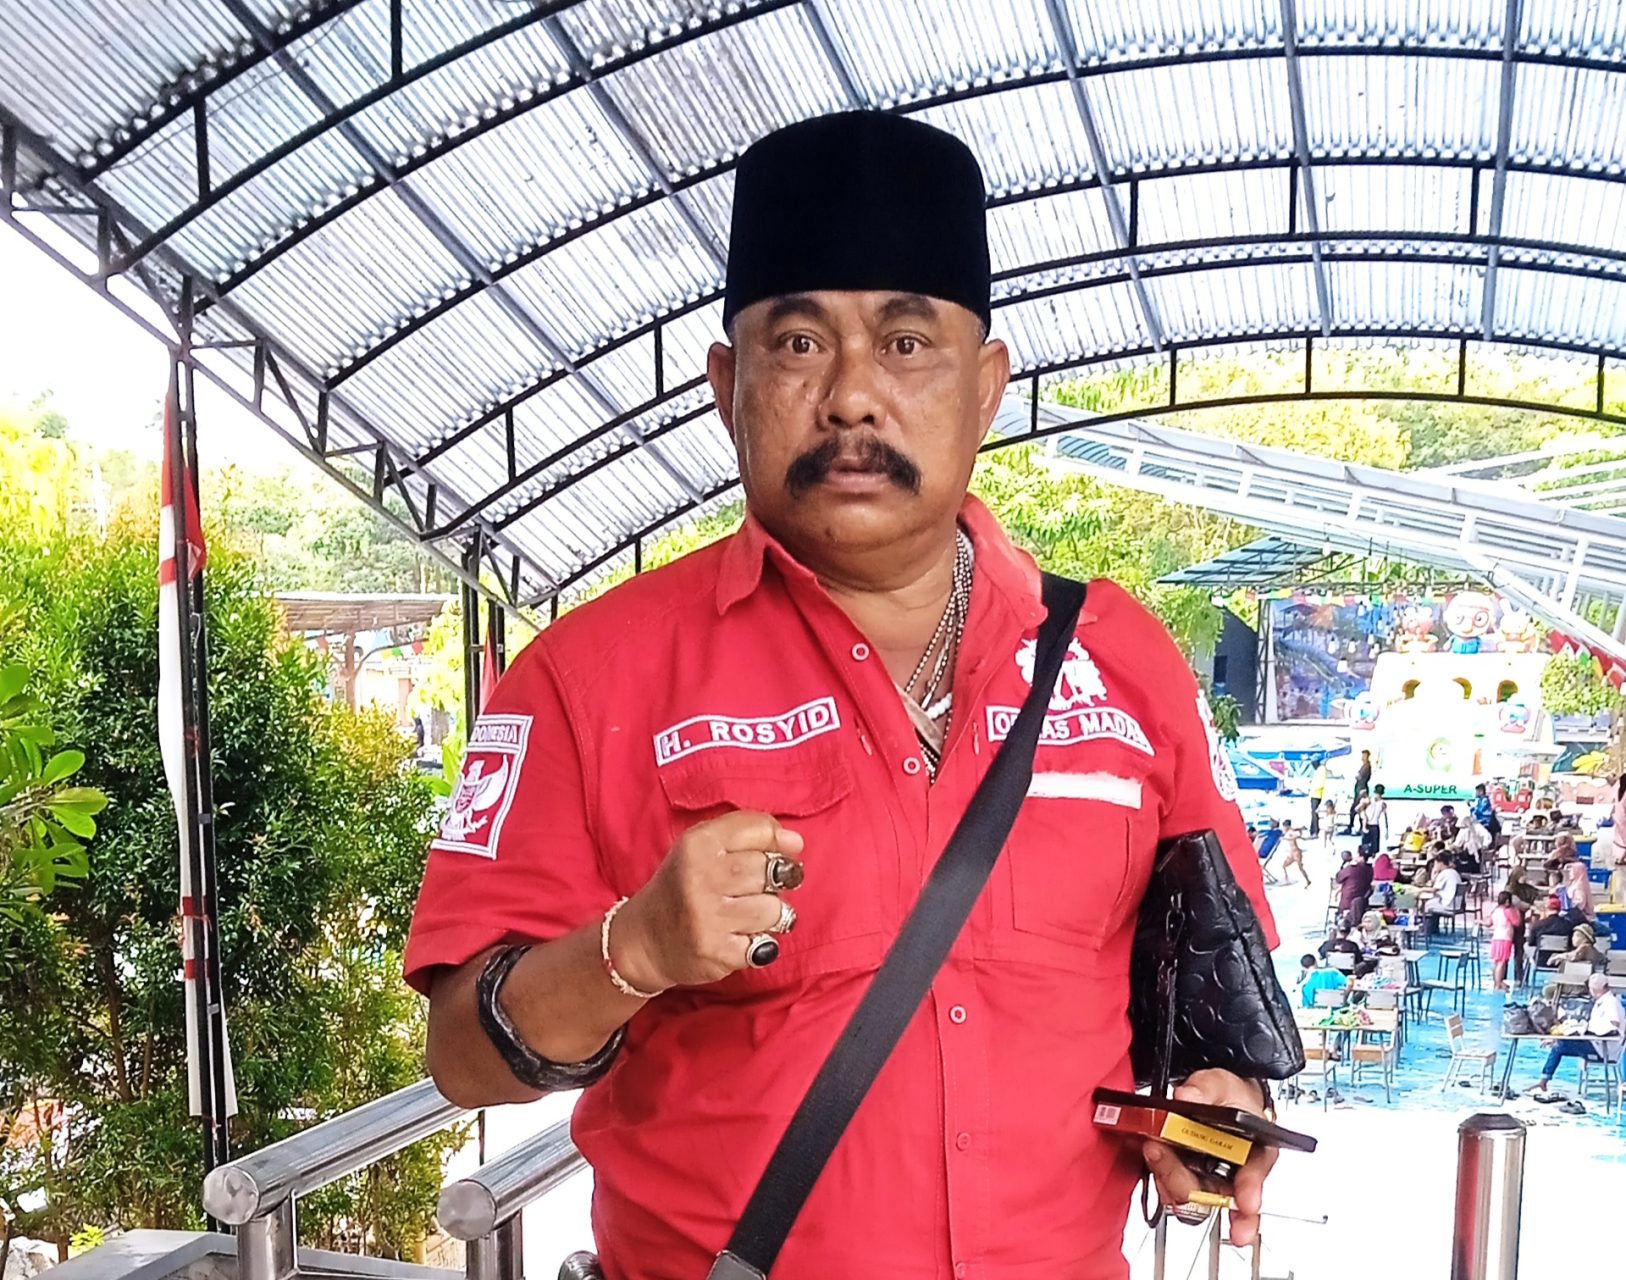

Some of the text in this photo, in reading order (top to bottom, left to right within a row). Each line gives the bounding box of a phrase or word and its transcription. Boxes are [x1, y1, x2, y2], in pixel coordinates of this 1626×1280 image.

[660, 704, 830, 757] H. ROSYID
[994, 712, 1070, 739] OAS
[1403, 784, 1457, 794] A-SUPER
